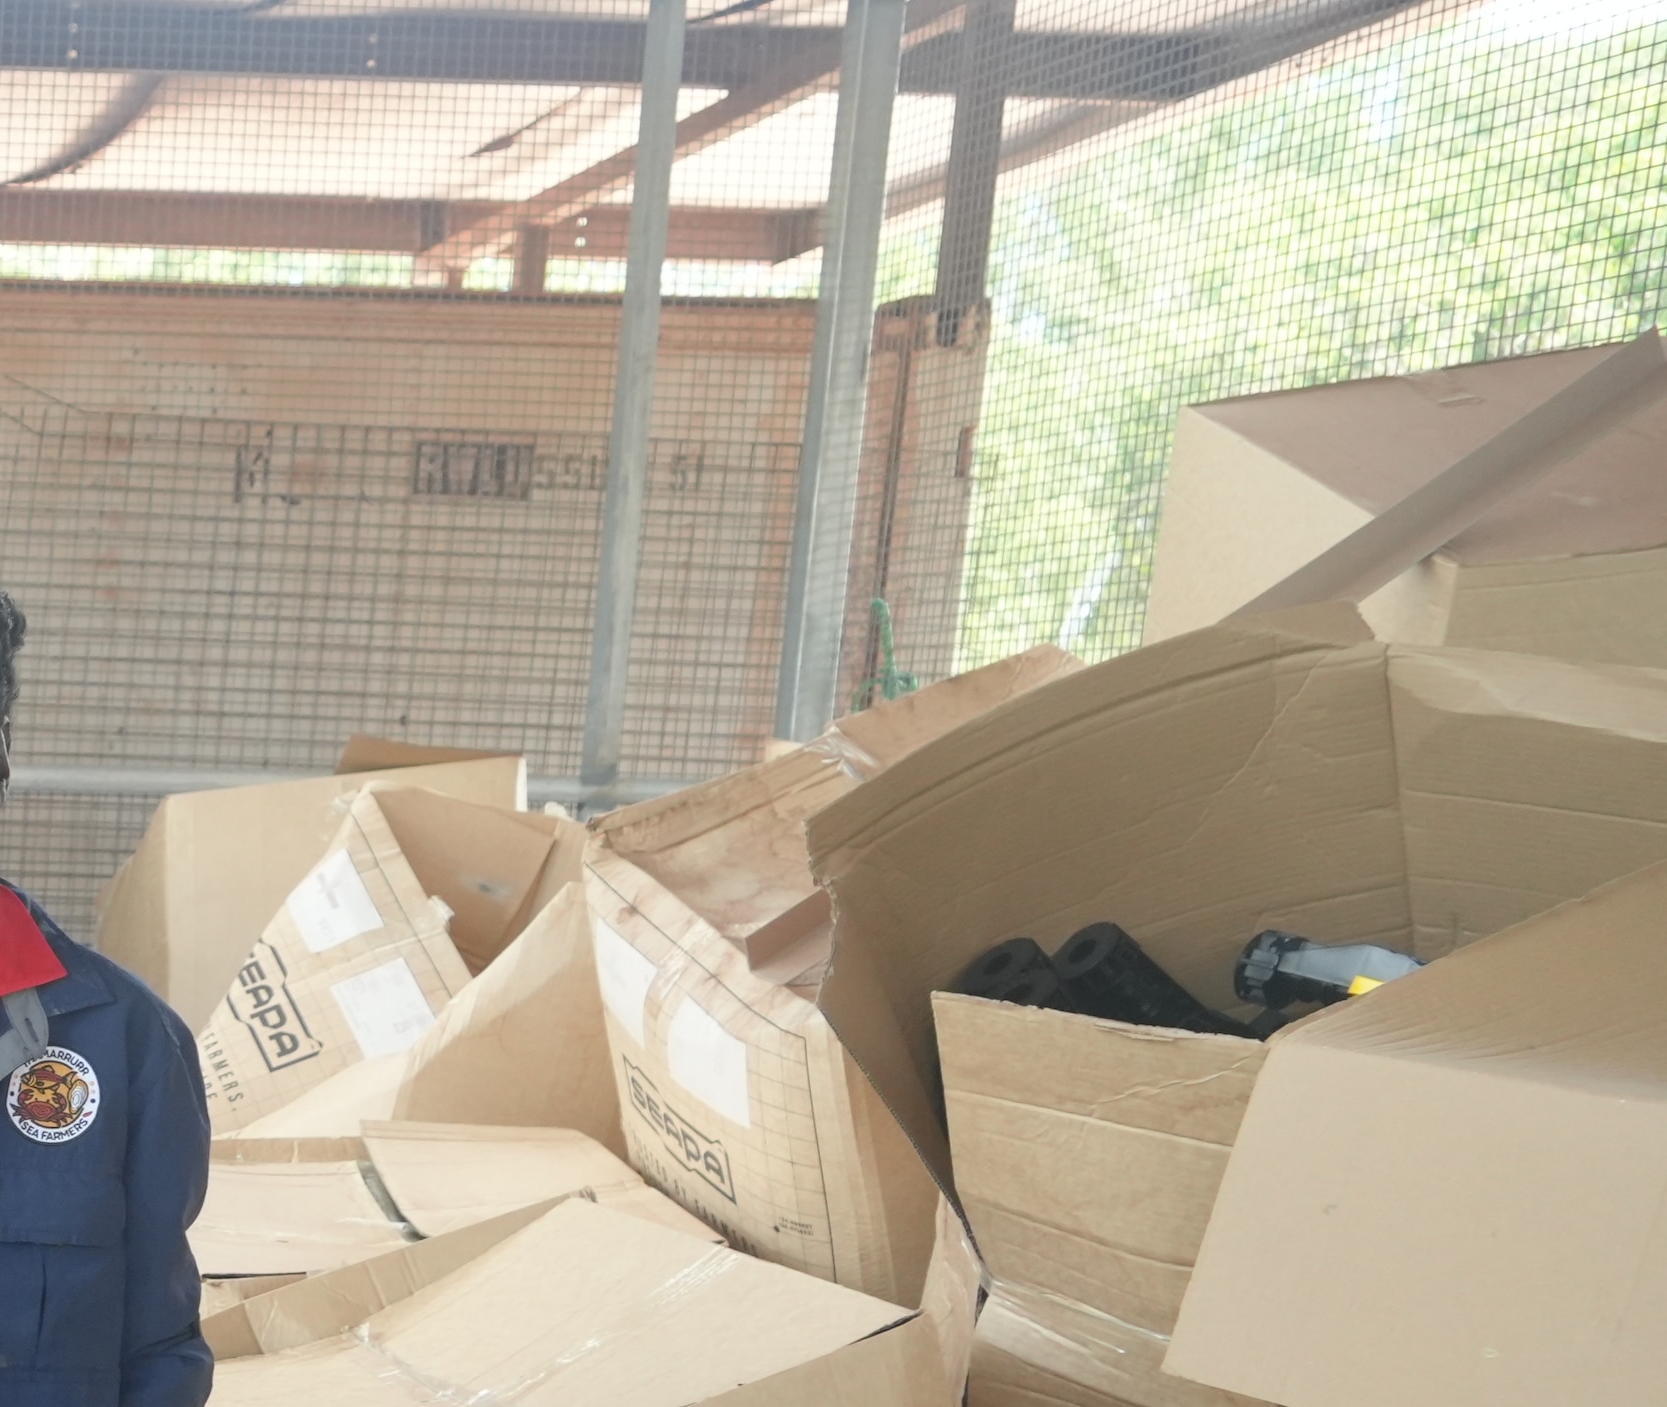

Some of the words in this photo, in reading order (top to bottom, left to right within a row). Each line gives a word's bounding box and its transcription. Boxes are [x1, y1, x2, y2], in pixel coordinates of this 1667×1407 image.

[238, 952, 299, 1058] EAPA
[21, 1121, 39, 1138] SEA
[41, 1118, 88, 1141] FARMERS
[631, 1076, 726, 1184] SEAPA
